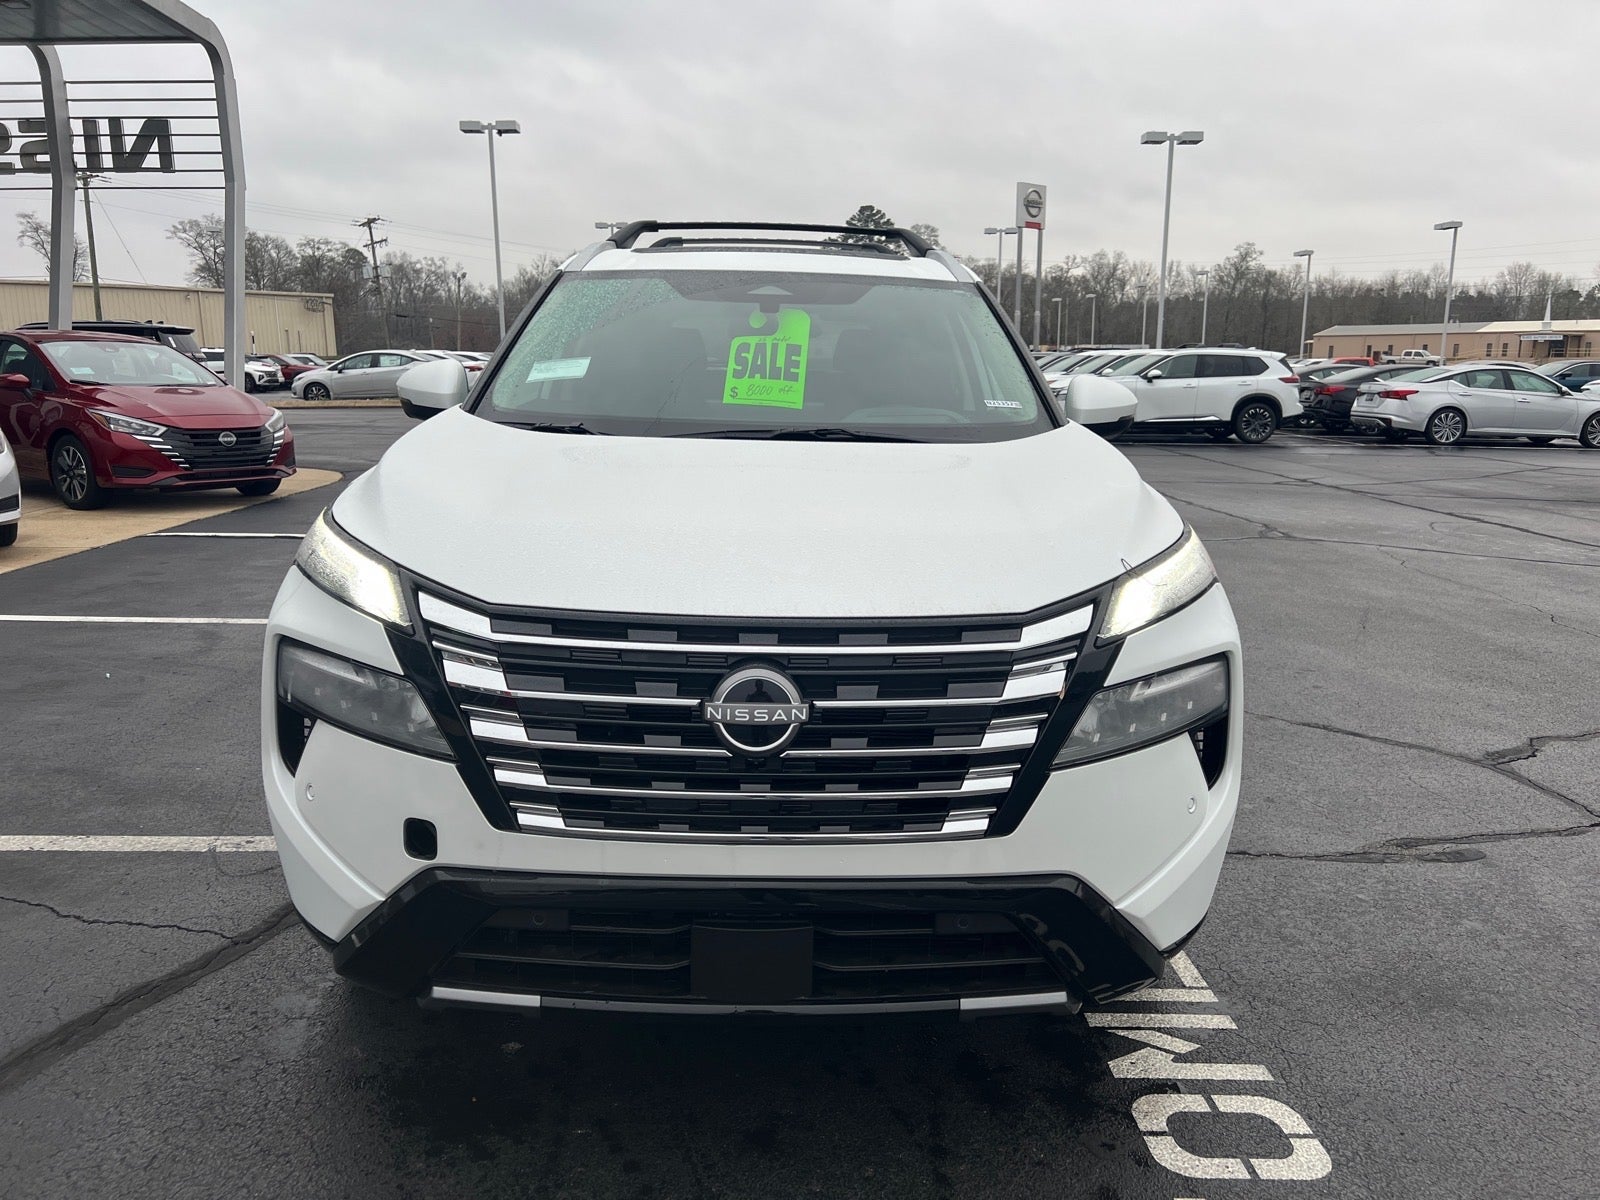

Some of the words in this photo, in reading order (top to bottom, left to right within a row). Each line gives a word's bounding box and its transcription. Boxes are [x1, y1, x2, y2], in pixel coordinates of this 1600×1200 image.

[732, 342, 802, 382] SALE
[745, 383, 773, 397] 8000
[707, 706, 806, 722] NISSAN
